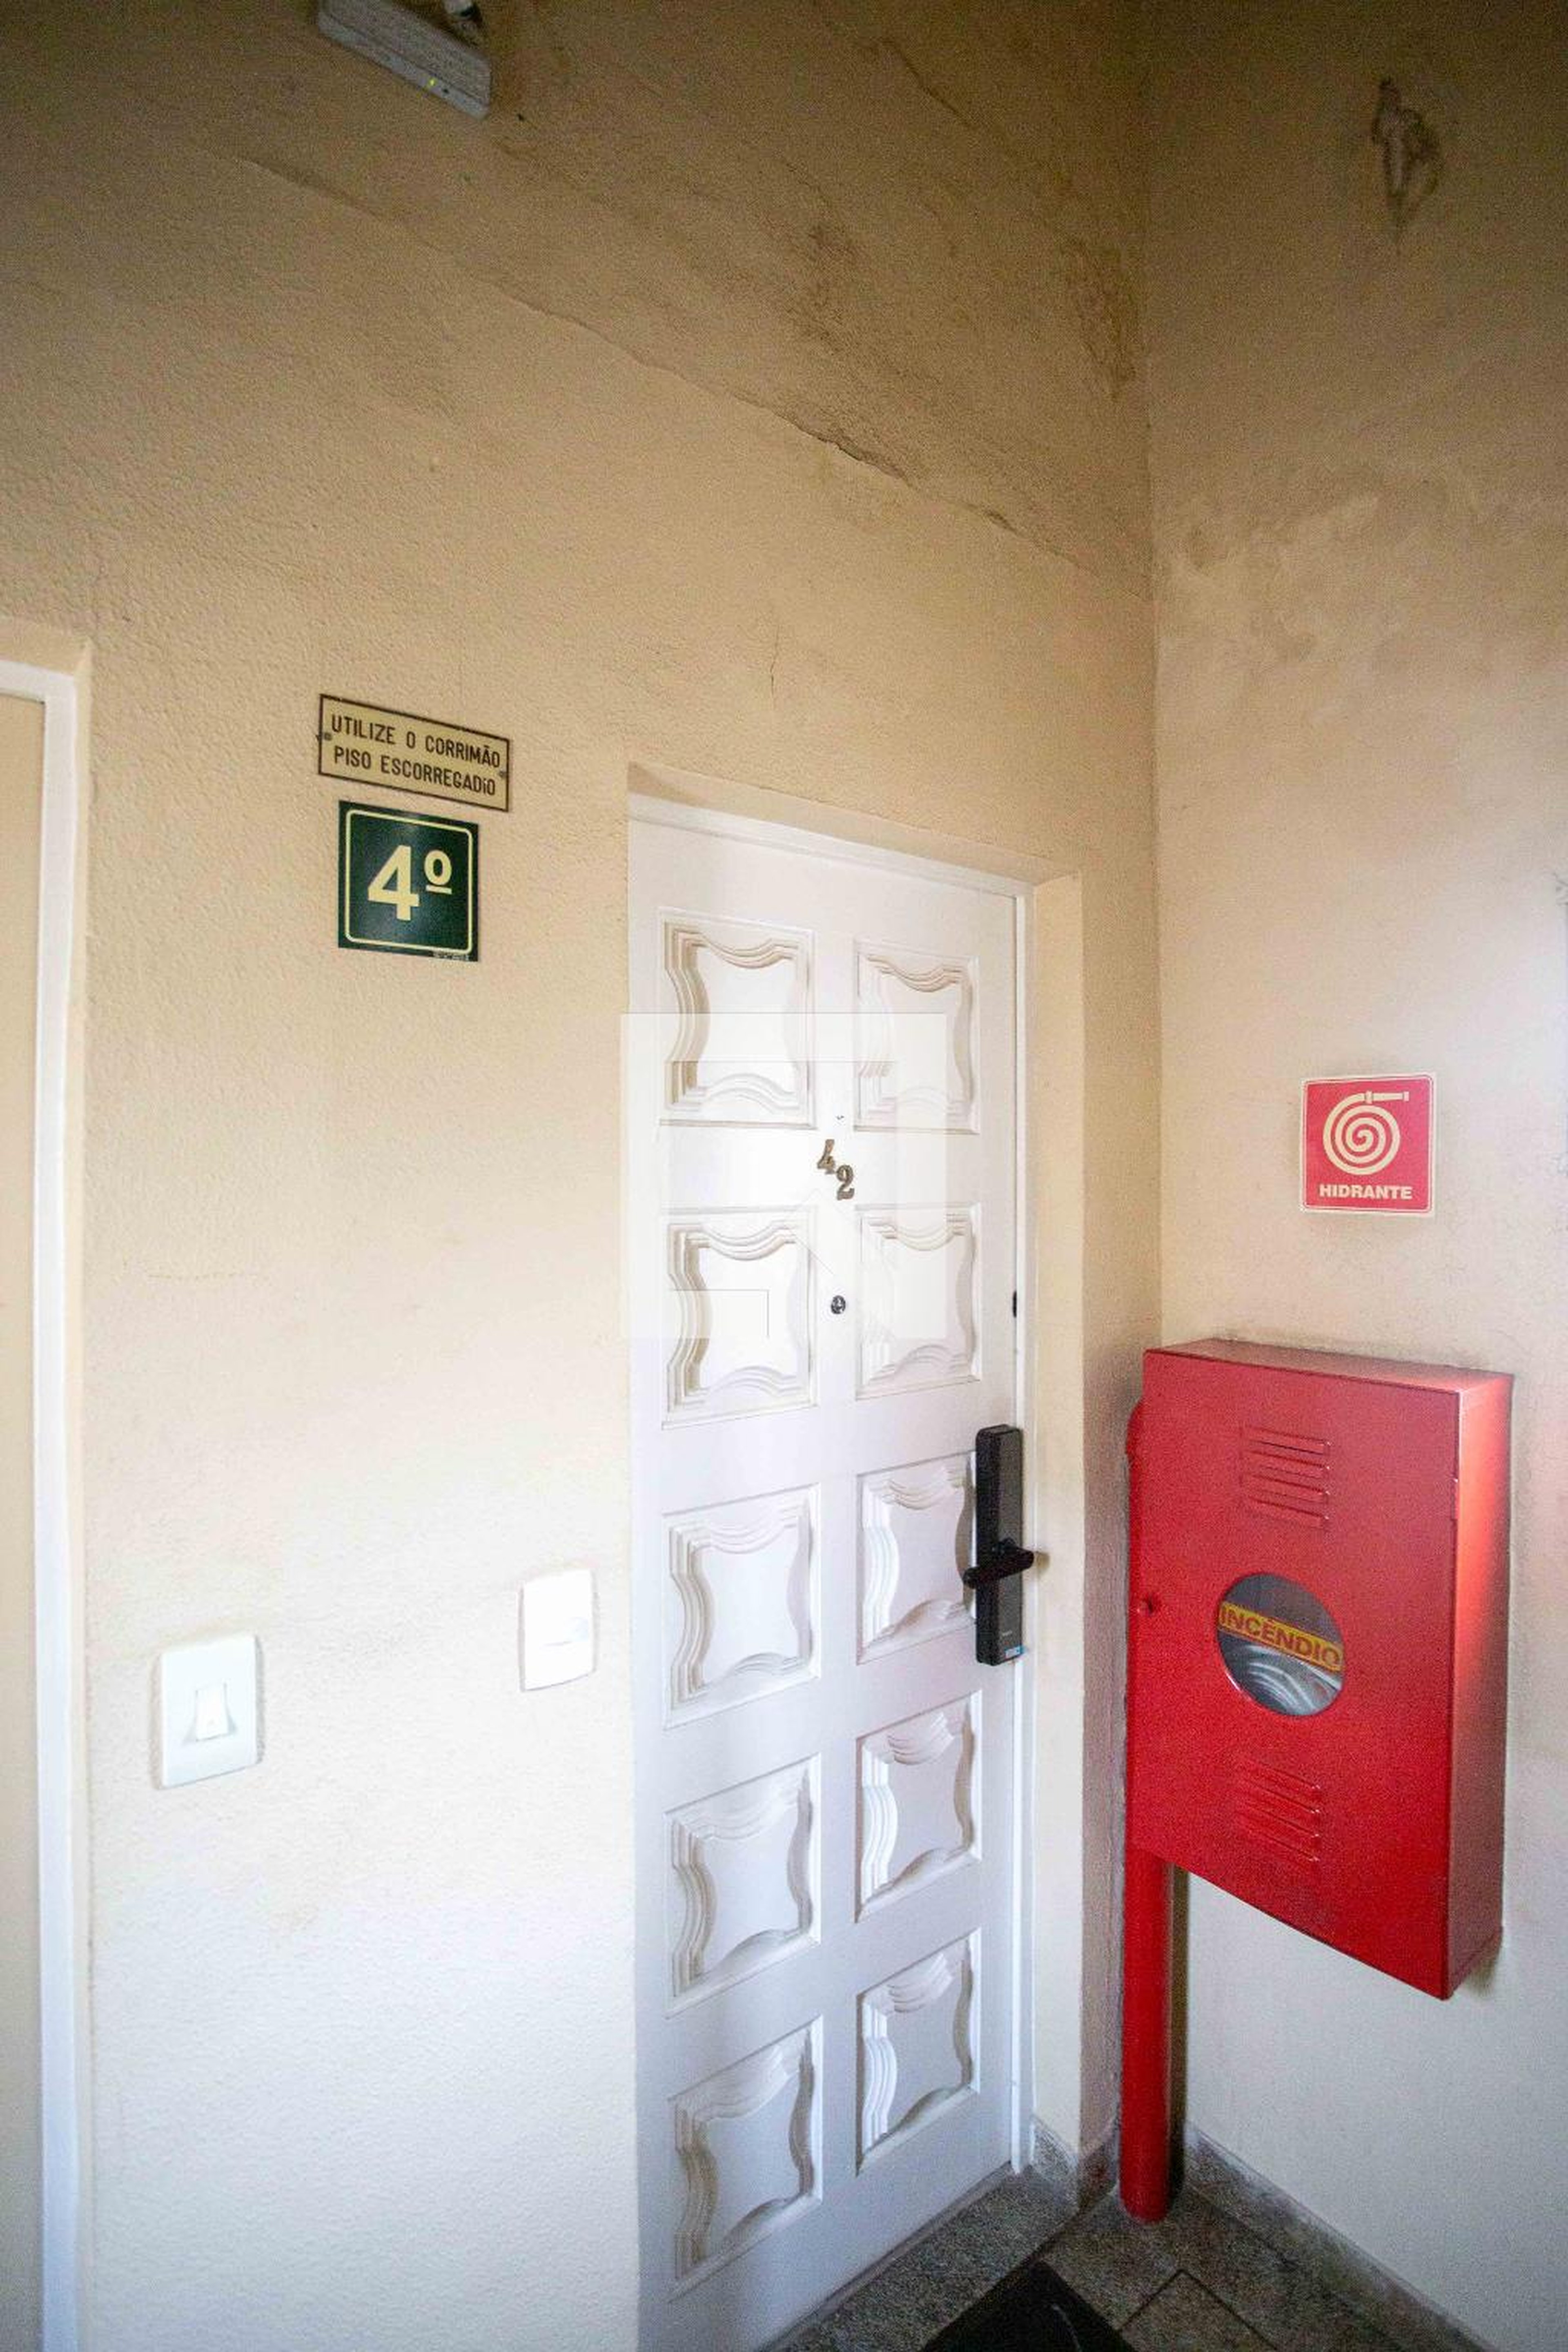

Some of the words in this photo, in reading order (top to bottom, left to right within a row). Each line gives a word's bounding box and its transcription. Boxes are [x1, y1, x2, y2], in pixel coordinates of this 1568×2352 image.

[332, 715, 395, 744] UTILIZE
[406, 732, 416, 748] O
[425, 735, 500, 767] CORRIMÃO
[334, 746, 371, 769] PISO
[817, 1139, 854, 1200] 42
[1319, 1184, 1412, 1199] HIDRANTE
